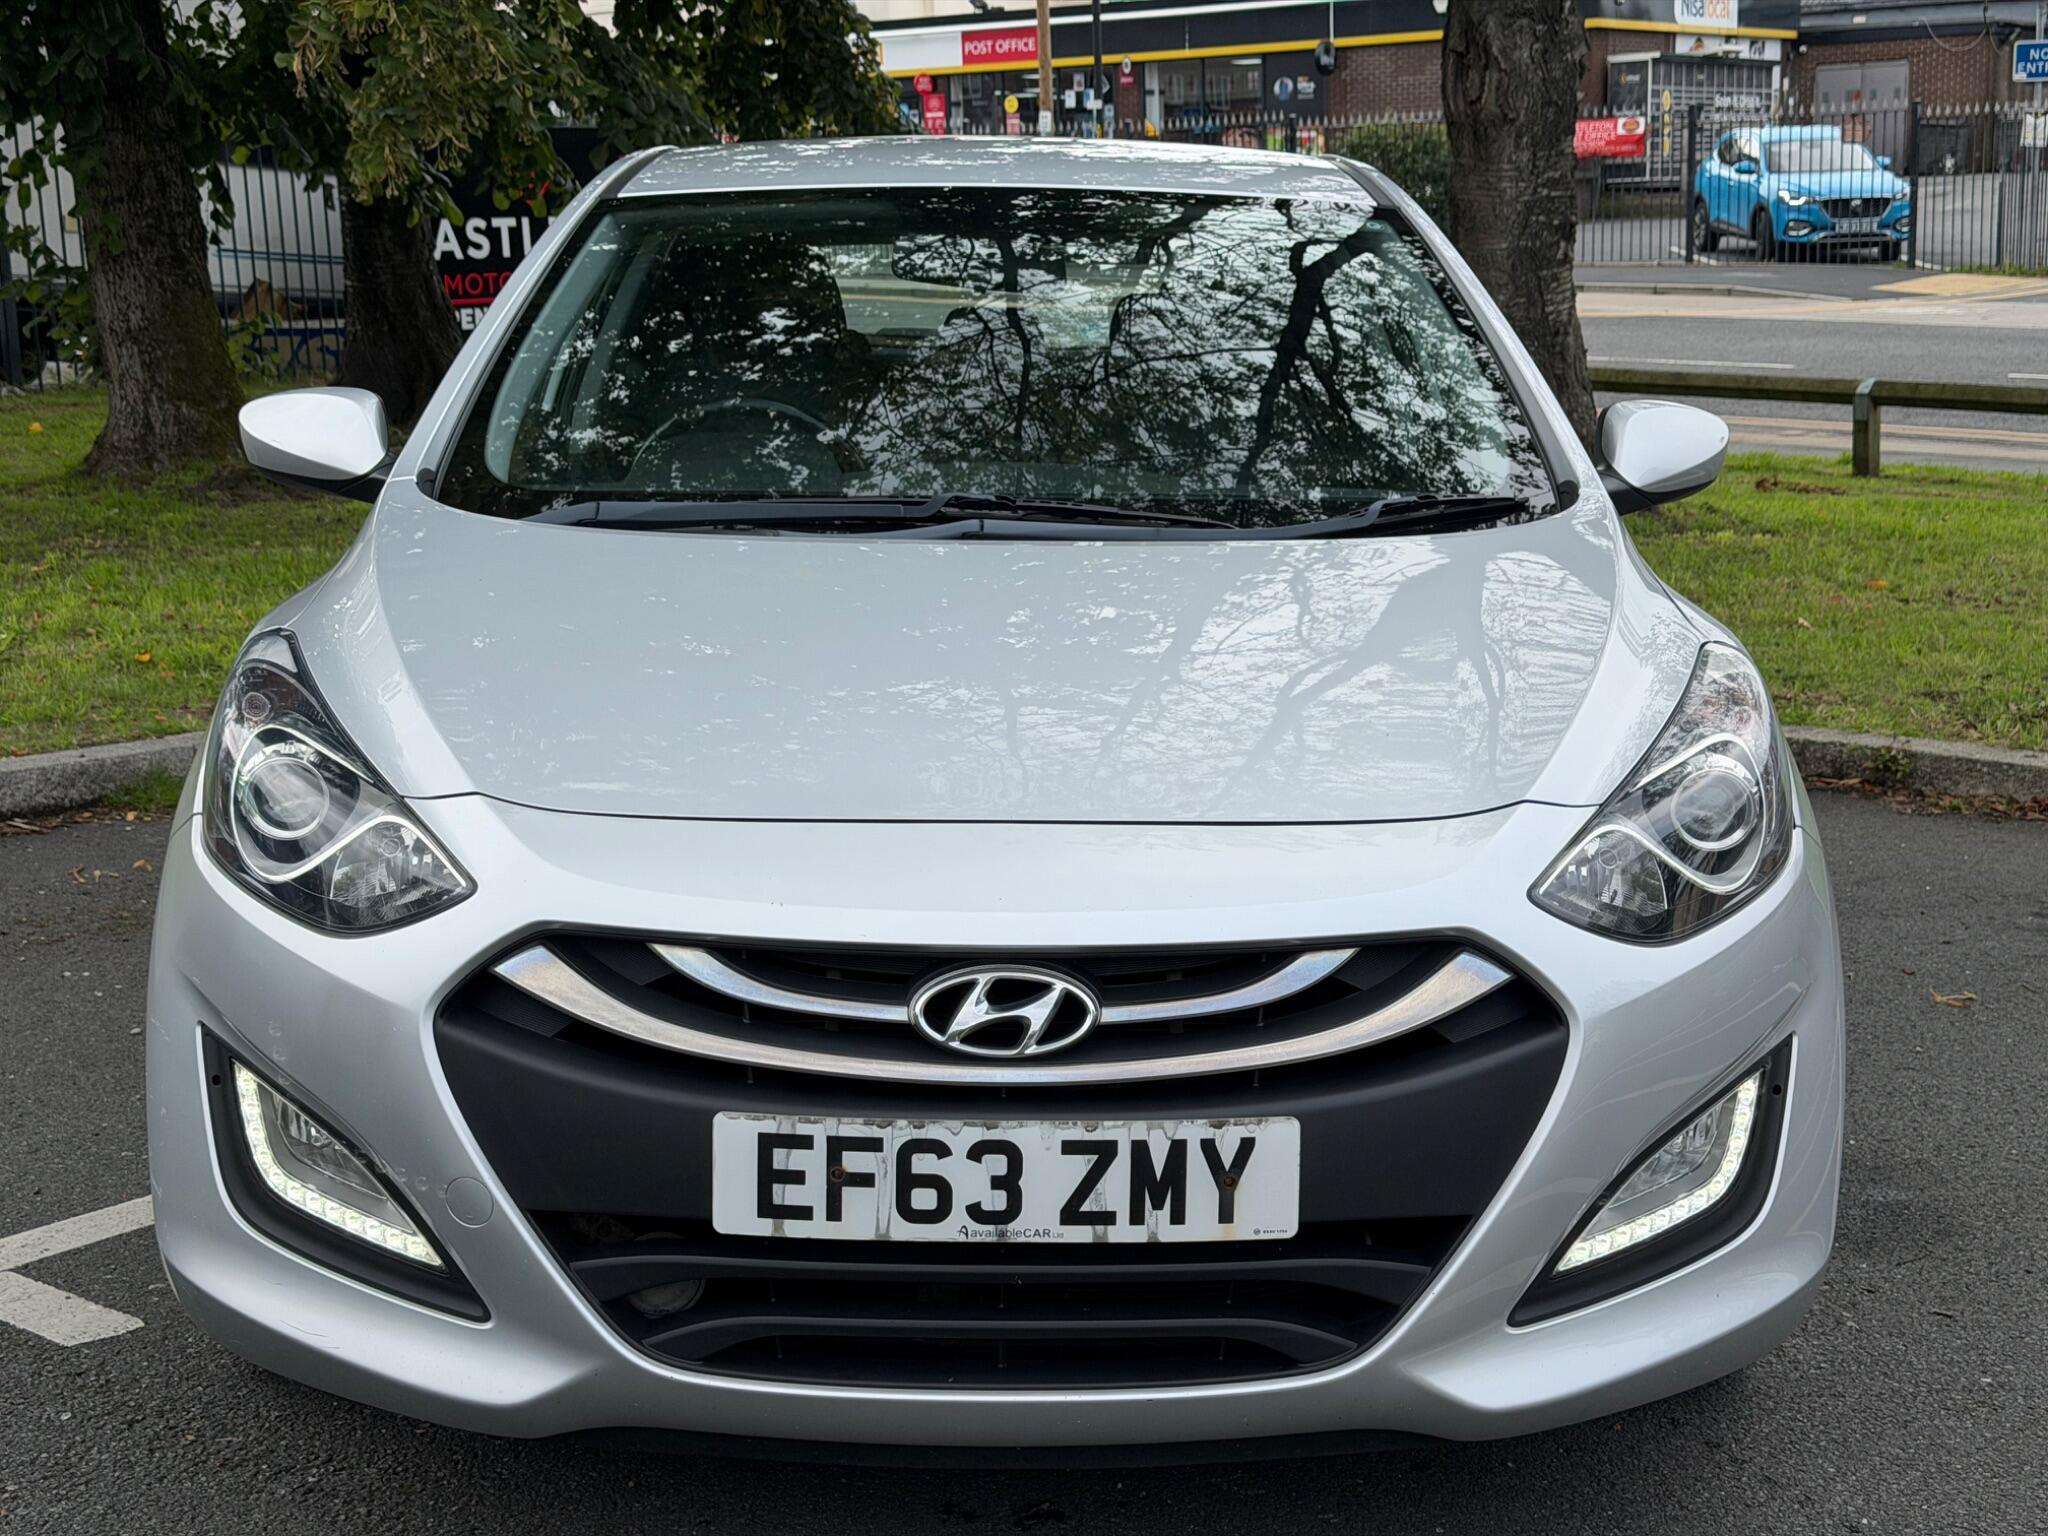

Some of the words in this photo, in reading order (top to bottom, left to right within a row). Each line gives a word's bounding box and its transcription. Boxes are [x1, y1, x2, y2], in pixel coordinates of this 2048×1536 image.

[965, 41, 993, 55] POST
[995, 37, 1037, 54] OFFICE
[757, 1132, 1023, 1225] EF63
[1059, 1137, 1256, 1226] ZMY
